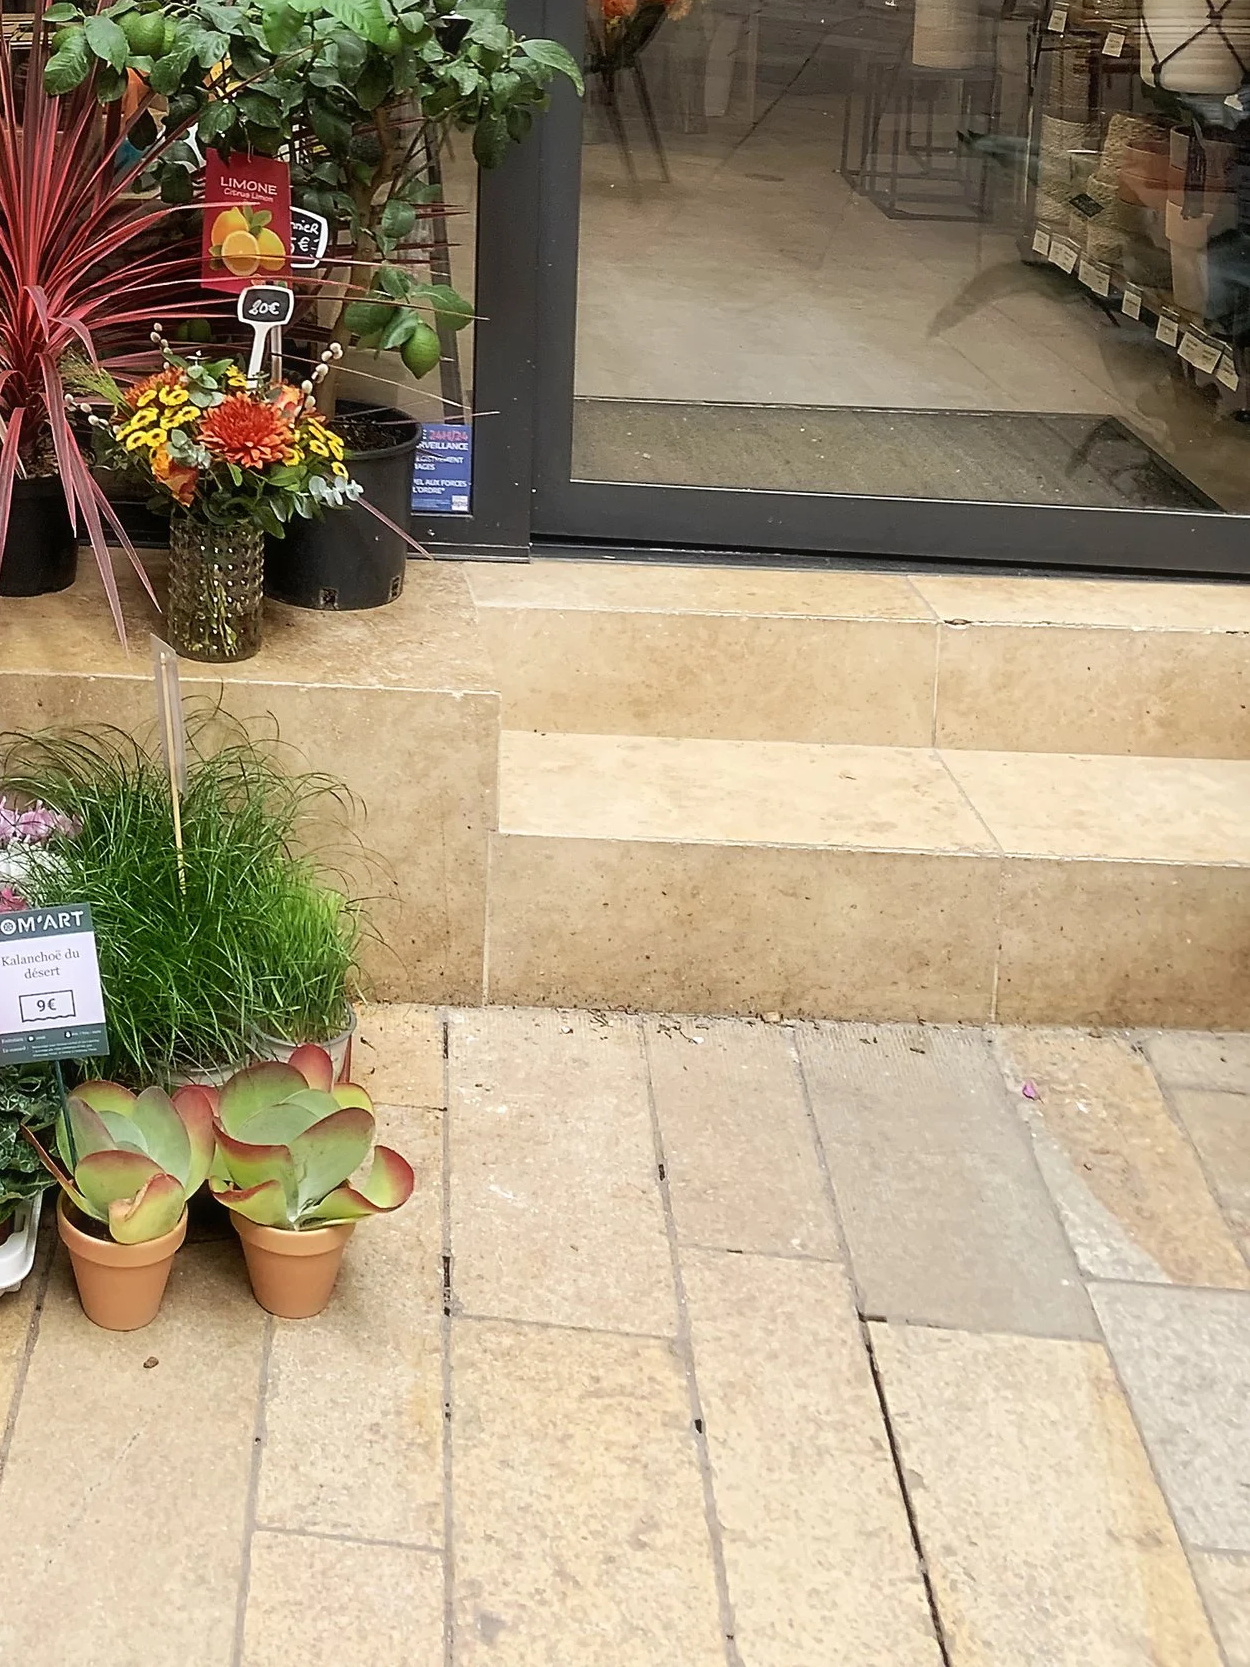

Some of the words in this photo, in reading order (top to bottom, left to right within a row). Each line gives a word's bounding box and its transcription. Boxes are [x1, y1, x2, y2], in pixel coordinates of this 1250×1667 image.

[220, 176, 278, 196] LIMONE
[0, 949, 62, 967] Kalanchoë
[64, 948, 81, 960] du
[24, 966, 61, 980] désert
[36, 998, 58, 1013] 9€
